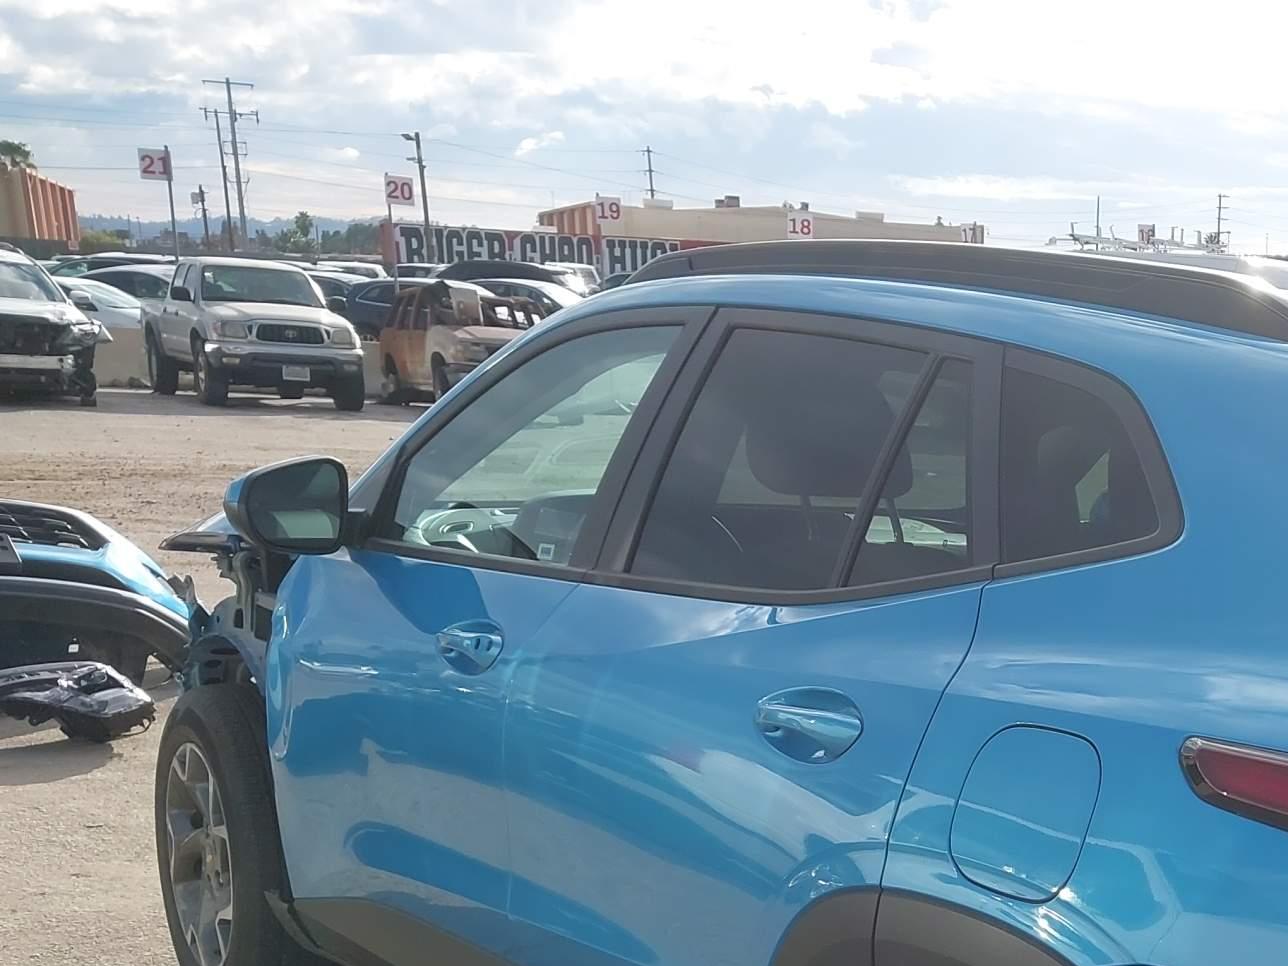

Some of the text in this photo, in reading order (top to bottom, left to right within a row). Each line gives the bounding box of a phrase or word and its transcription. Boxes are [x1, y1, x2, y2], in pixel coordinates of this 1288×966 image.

[139, 154, 168, 175] 21
[386, 180, 413, 201] 20
[598, 202, 621, 220] 19
[788, 218, 812, 235] 18
